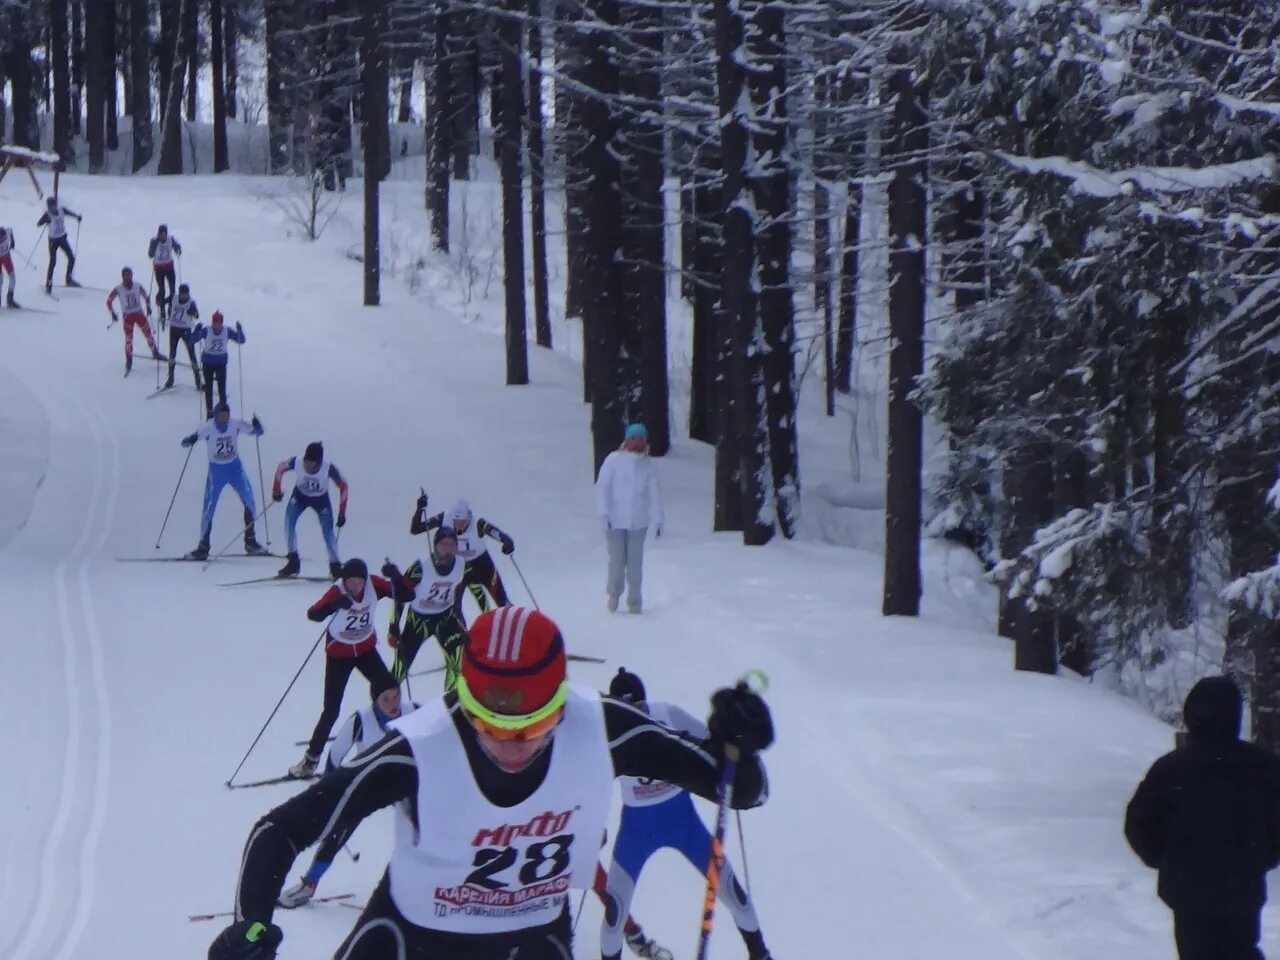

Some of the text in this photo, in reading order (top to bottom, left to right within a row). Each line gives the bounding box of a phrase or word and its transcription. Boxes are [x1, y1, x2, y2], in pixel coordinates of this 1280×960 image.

[216, 441, 234, 455] 25
[429, 586, 452, 602] 24
[345, 611, 370, 631] 29
[463, 833, 576, 890] 28
